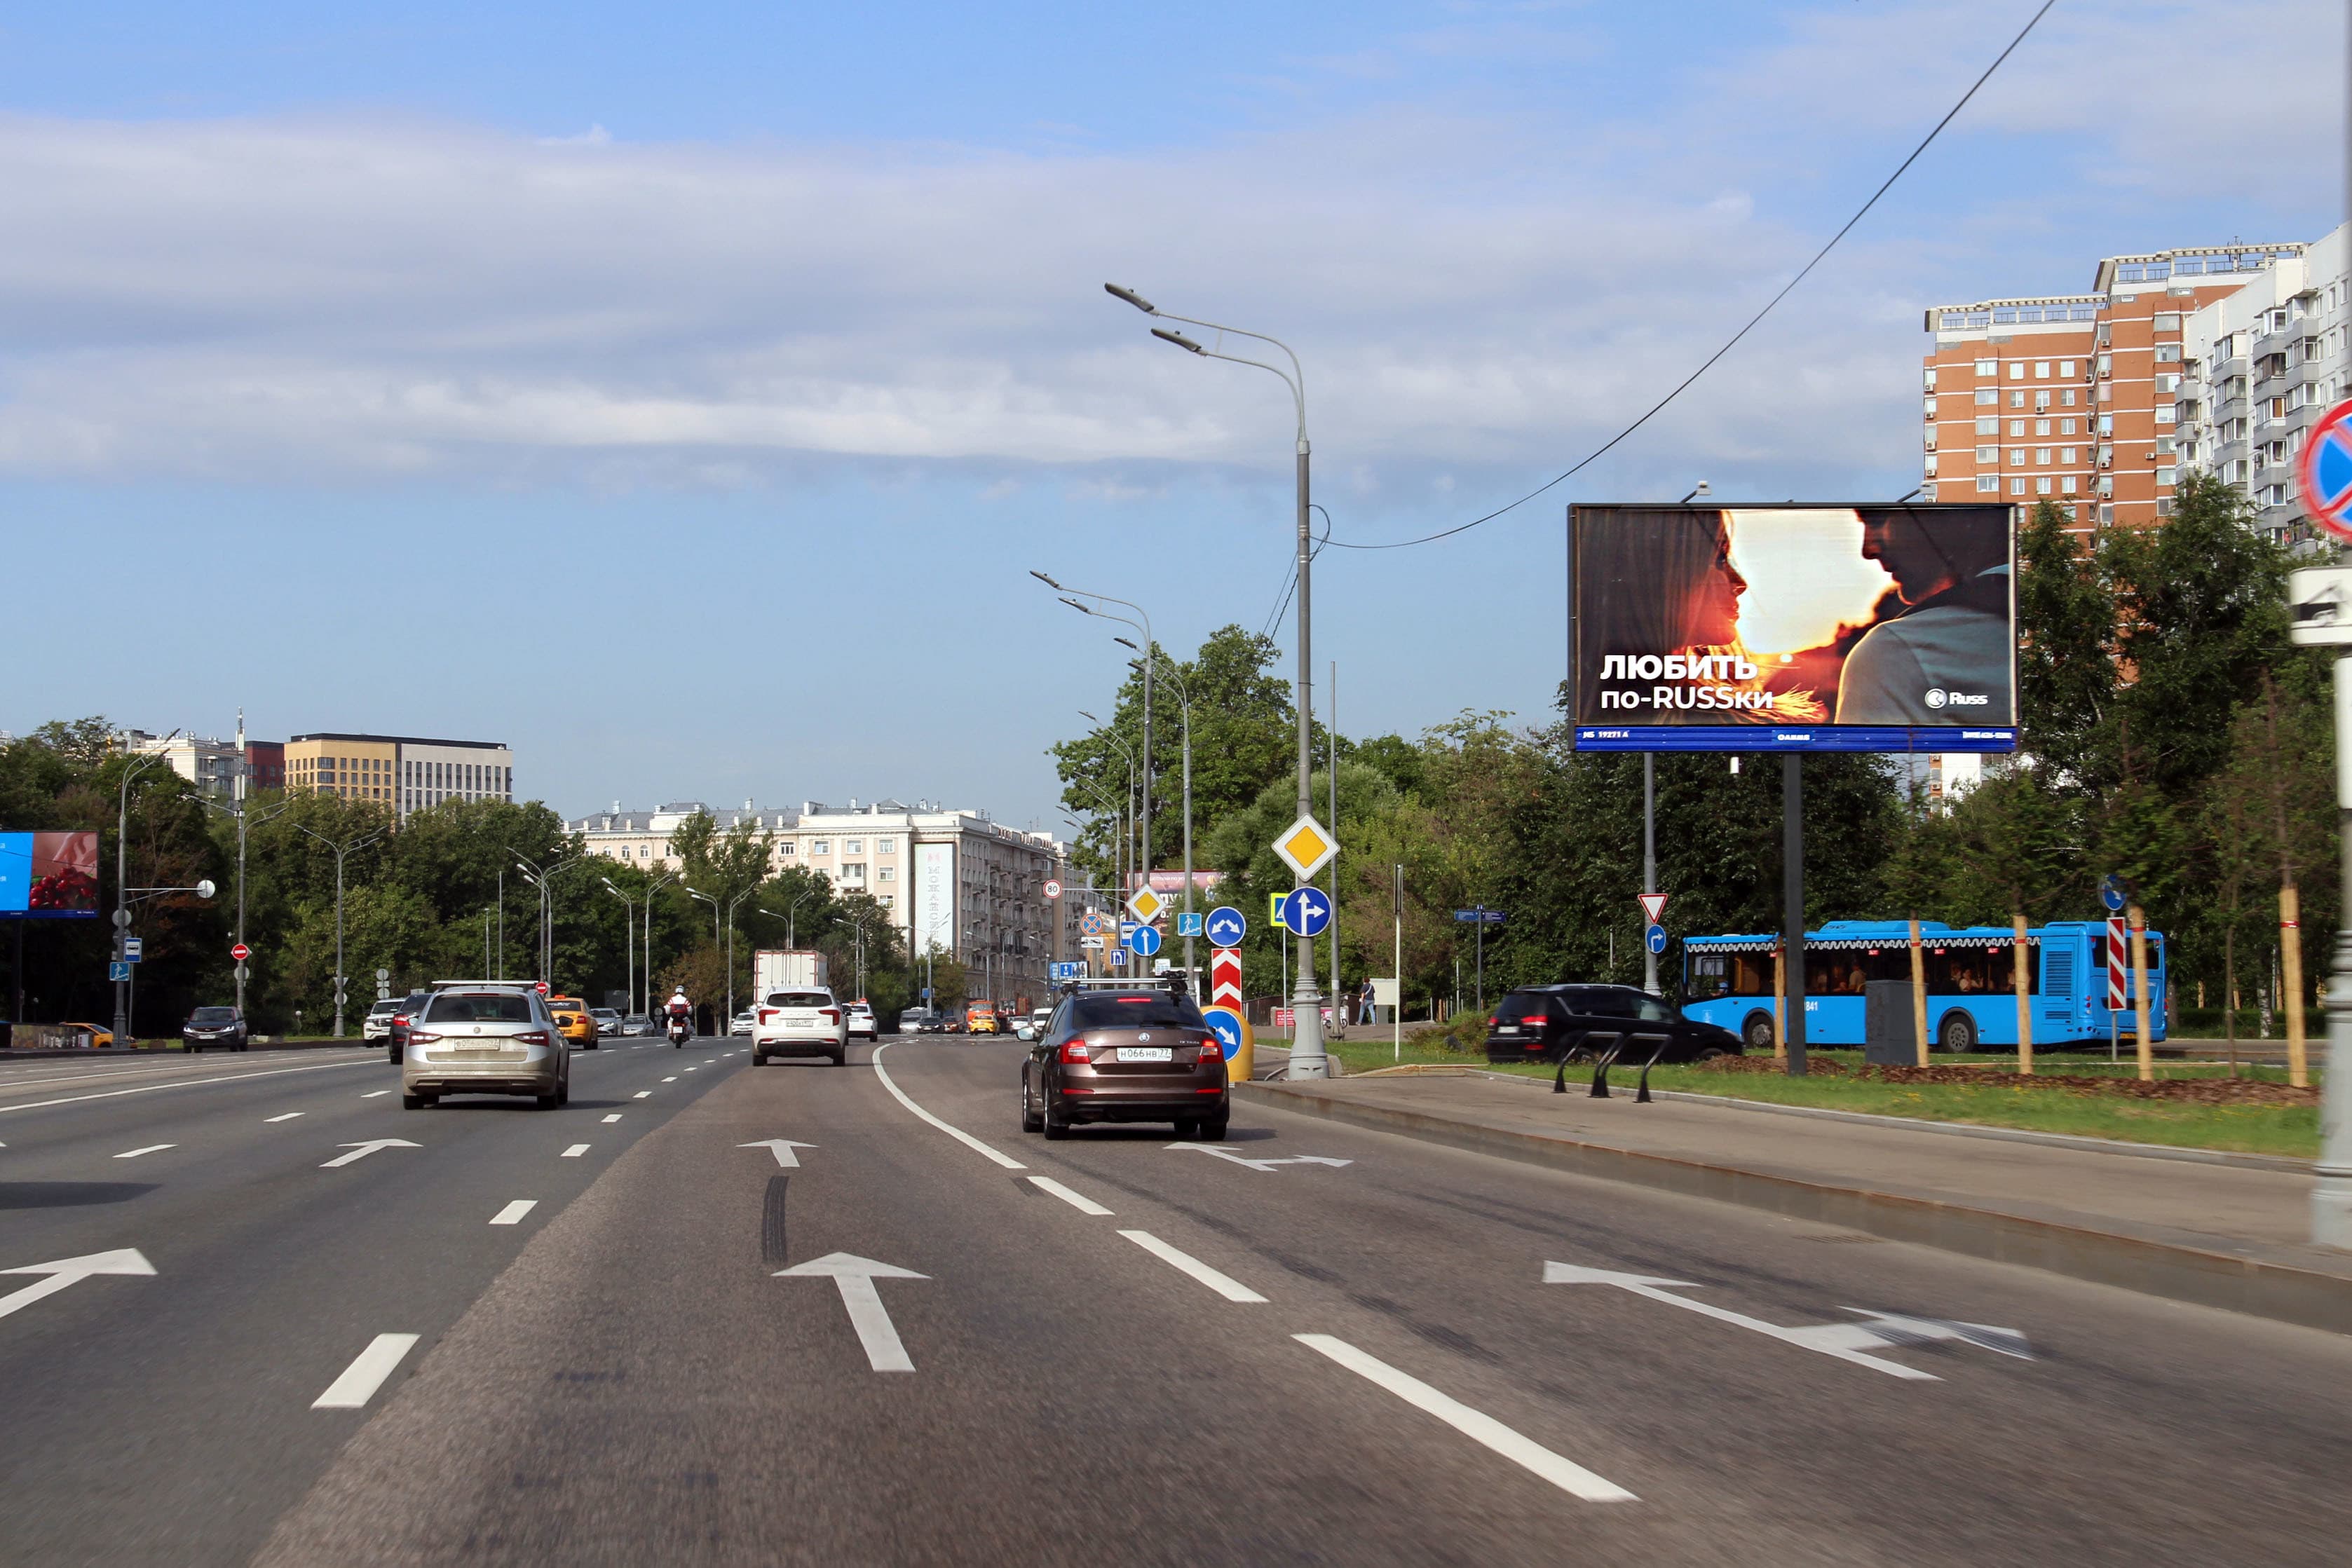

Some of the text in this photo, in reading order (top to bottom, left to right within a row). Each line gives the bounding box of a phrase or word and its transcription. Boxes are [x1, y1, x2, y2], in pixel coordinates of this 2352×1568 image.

[1600, 655, 1758, 680] ЛЮБИТЬ
[1601, 686, 1773, 709] по-RUSSки
[1804, 1001, 1819, 1011] 841
